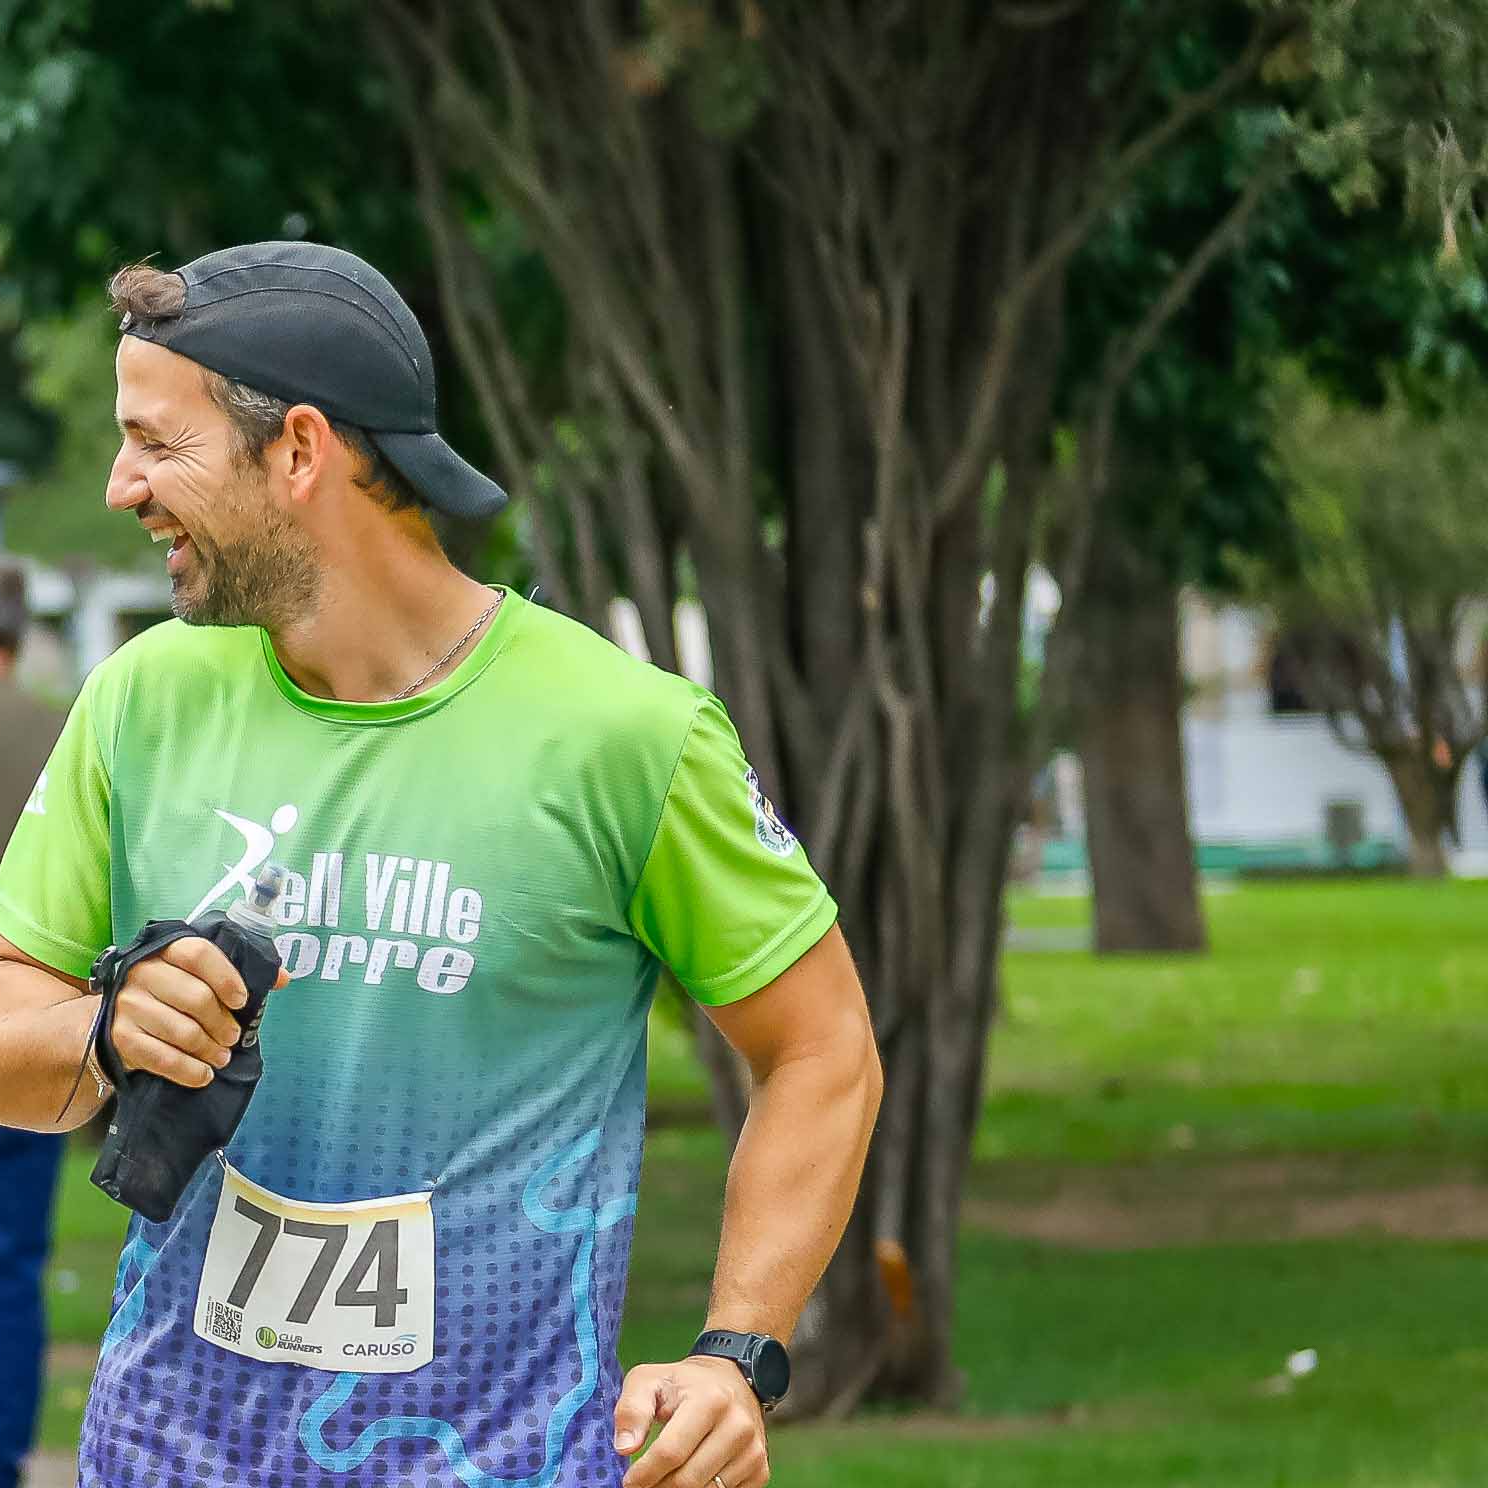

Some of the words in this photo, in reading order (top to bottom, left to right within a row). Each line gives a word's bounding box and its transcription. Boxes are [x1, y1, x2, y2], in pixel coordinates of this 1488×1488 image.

[365, 853, 483, 944] Ville
[273, 932, 475, 995] orre
[226, 1195, 408, 1328] 774
[278, 1333, 303, 1343] CLUB
[342, 1343, 415, 1356] CARUSO
